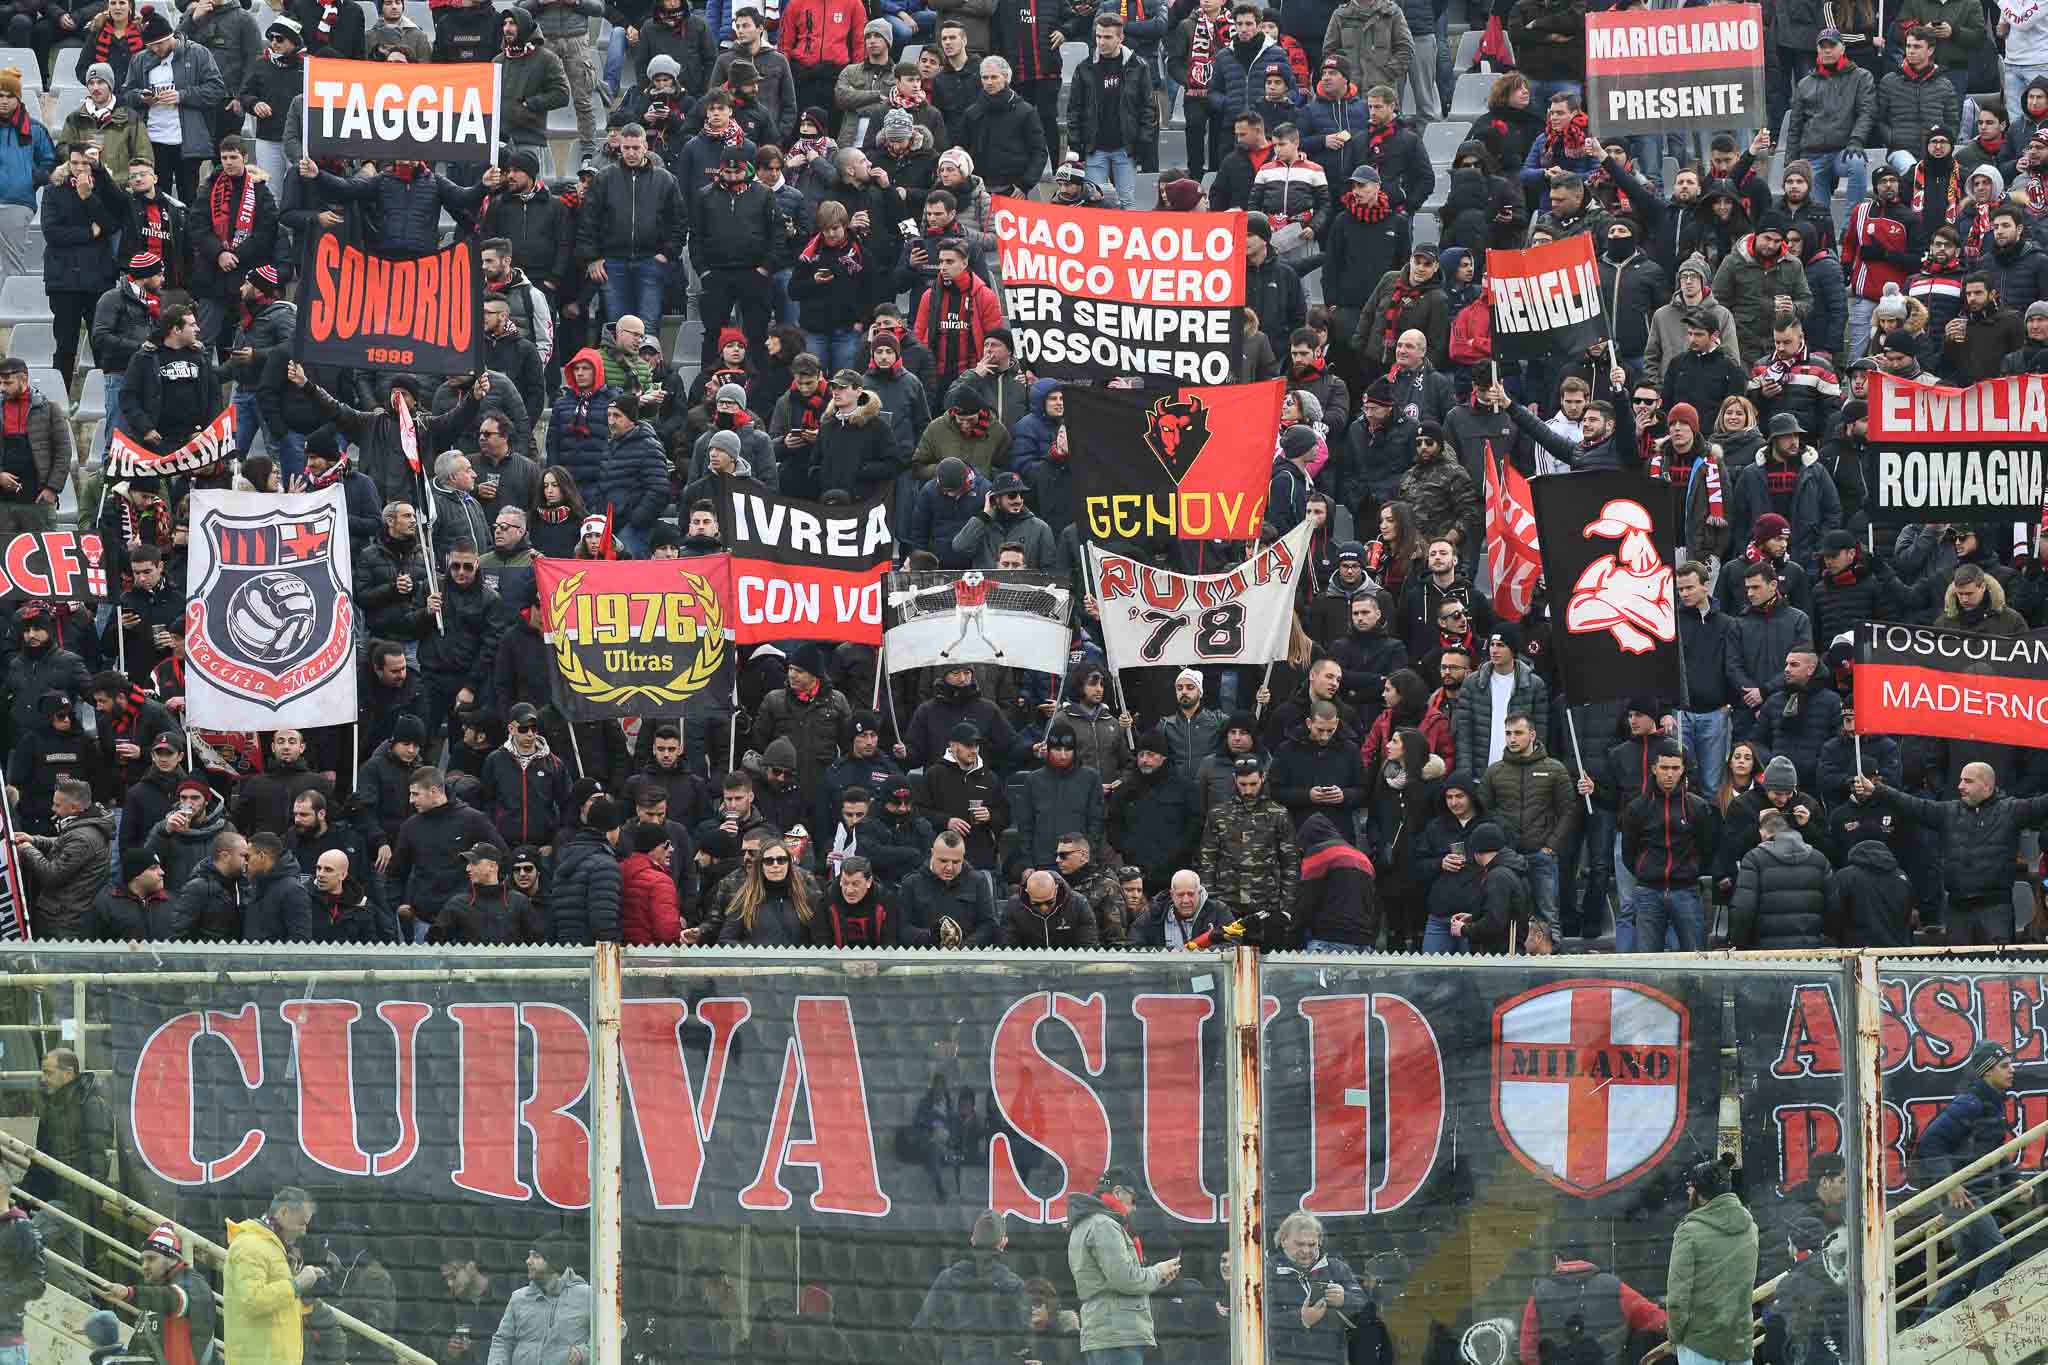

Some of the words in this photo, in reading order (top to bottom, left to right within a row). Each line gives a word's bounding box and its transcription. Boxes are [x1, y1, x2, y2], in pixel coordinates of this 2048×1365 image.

[1589, 18, 1760, 59] MARIGLIANO
[314, 80, 488, 144] TAGGIA
[1608, 83, 1745, 121] PRESENTE
[995, 210, 1084, 254] CIAO
[1098, 224, 1234, 262] PAOLO
[310, 232, 472, 352] SONDRIO
[1002, 248, 1114, 295] AMICO
[1127, 267, 1232, 302] VERO
[1073, 301, 1231, 343] SEMPRE
[1881, 375, 2048, 433] EMILIA
[106, 416, 236, 477] TOSCANA
[1879, 450, 2042, 508] ROMAGNA
[732, 492, 892, 557] IVREA
[0, 531, 81, 597] CF
[1099, 540, 1294, 612] ROMA
[575, 592, 698, 646] 1976
[737, 575, 820, 625] CON
[603, 650, 673, 672] Ultras
[1511, 1047, 1672, 1081] MILANO
[131, 995, 891, 1218] CURVA
[989, 990, 1446, 1224] SUD
